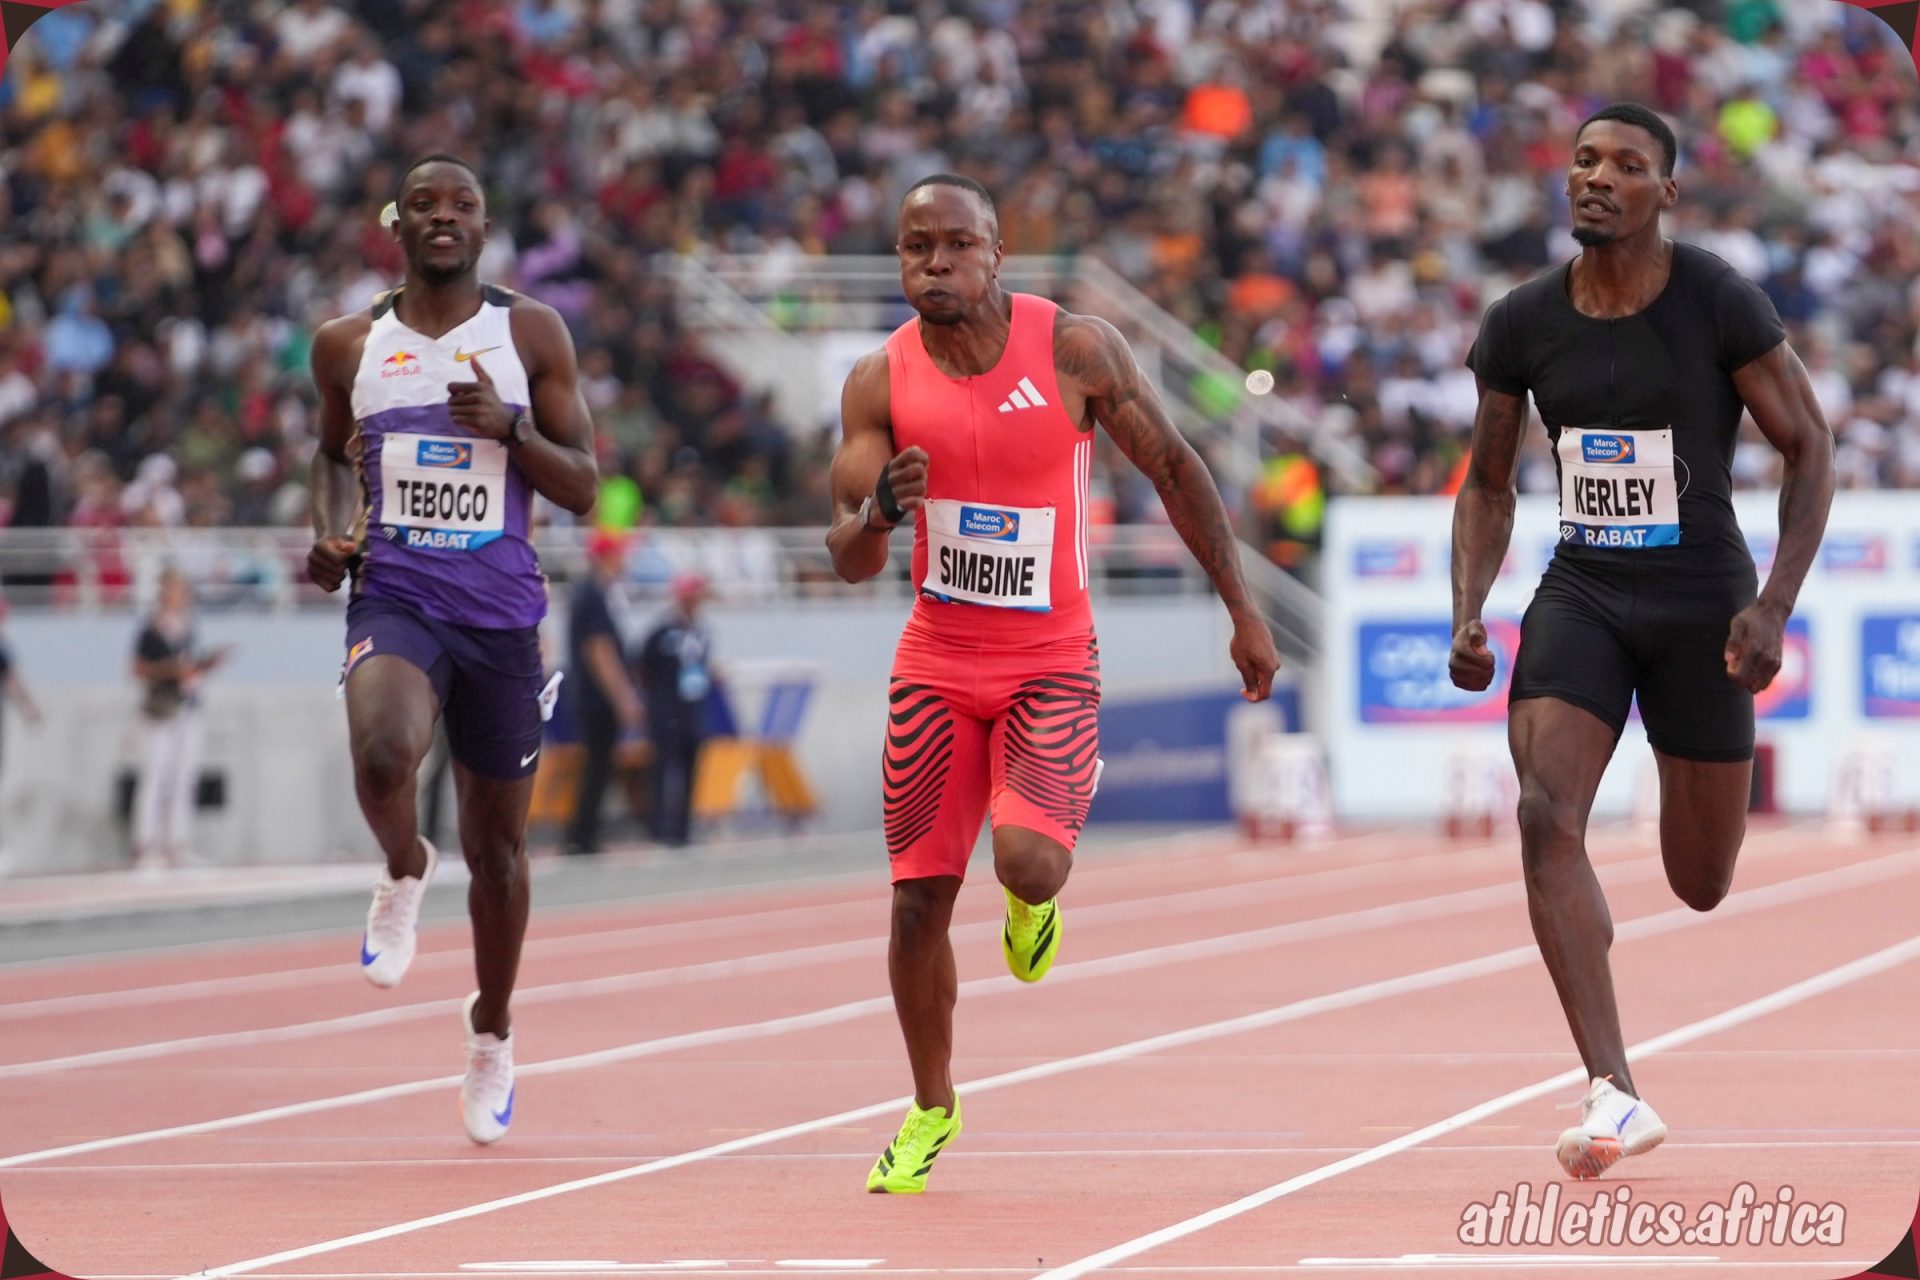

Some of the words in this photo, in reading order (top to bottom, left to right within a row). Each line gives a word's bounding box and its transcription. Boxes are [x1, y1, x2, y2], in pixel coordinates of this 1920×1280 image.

[430, 444, 456, 453] Maroc
[1593, 438, 1618, 448] Maroc
[422, 451, 456, 462] Telecom
[1586, 447, 1619, 456] Telecom
[397, 480, 487, 522] TEBOGO
[1574, 475, 1655, 517] KERLEY
[973, 512, 1001, 523] Maroc
[965, 519, 1001, 532] Telecom
[407, 529, 472, 549] RABAT
[1584, 529, 1647, 546] RABAT
[940, 545, 1035, 597] SIMBINE
